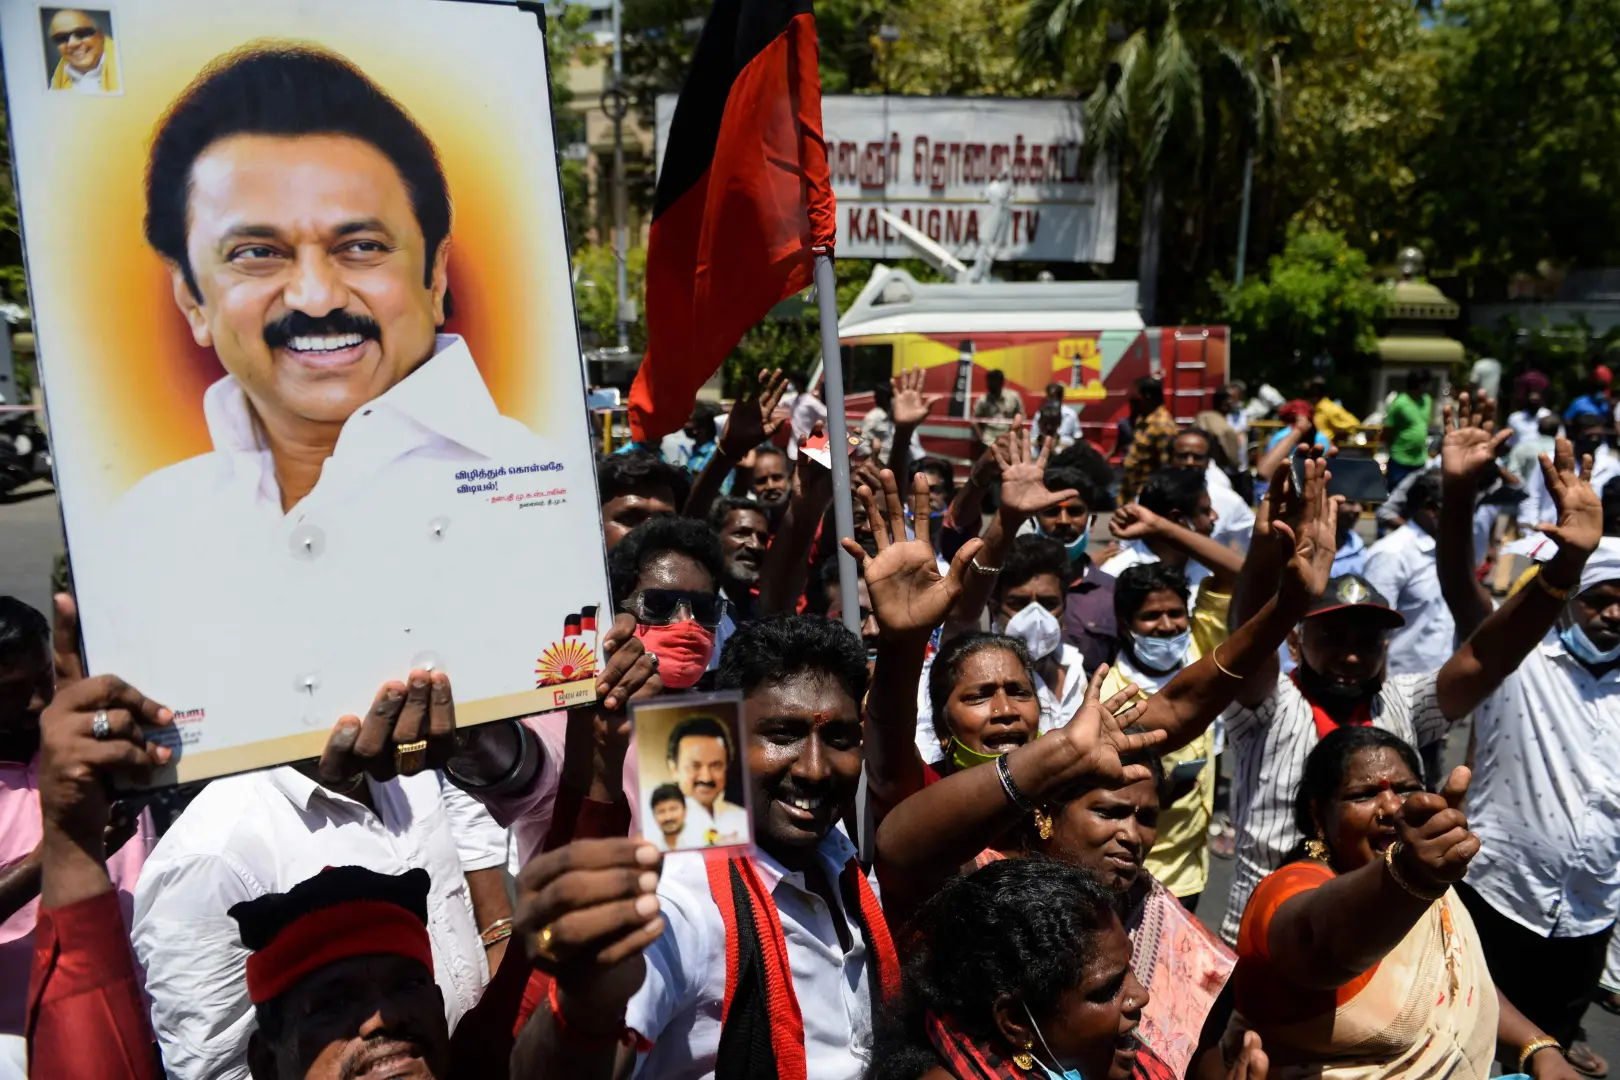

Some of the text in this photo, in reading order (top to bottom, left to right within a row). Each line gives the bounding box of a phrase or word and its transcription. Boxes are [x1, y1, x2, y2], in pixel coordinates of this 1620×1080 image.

[847, 206, 1040, 246] KALAIGNA TV
[455, 461, 564, 482] விழித்துக் கொள்வதே
[456, 481, 499, 495] விடியல்!
